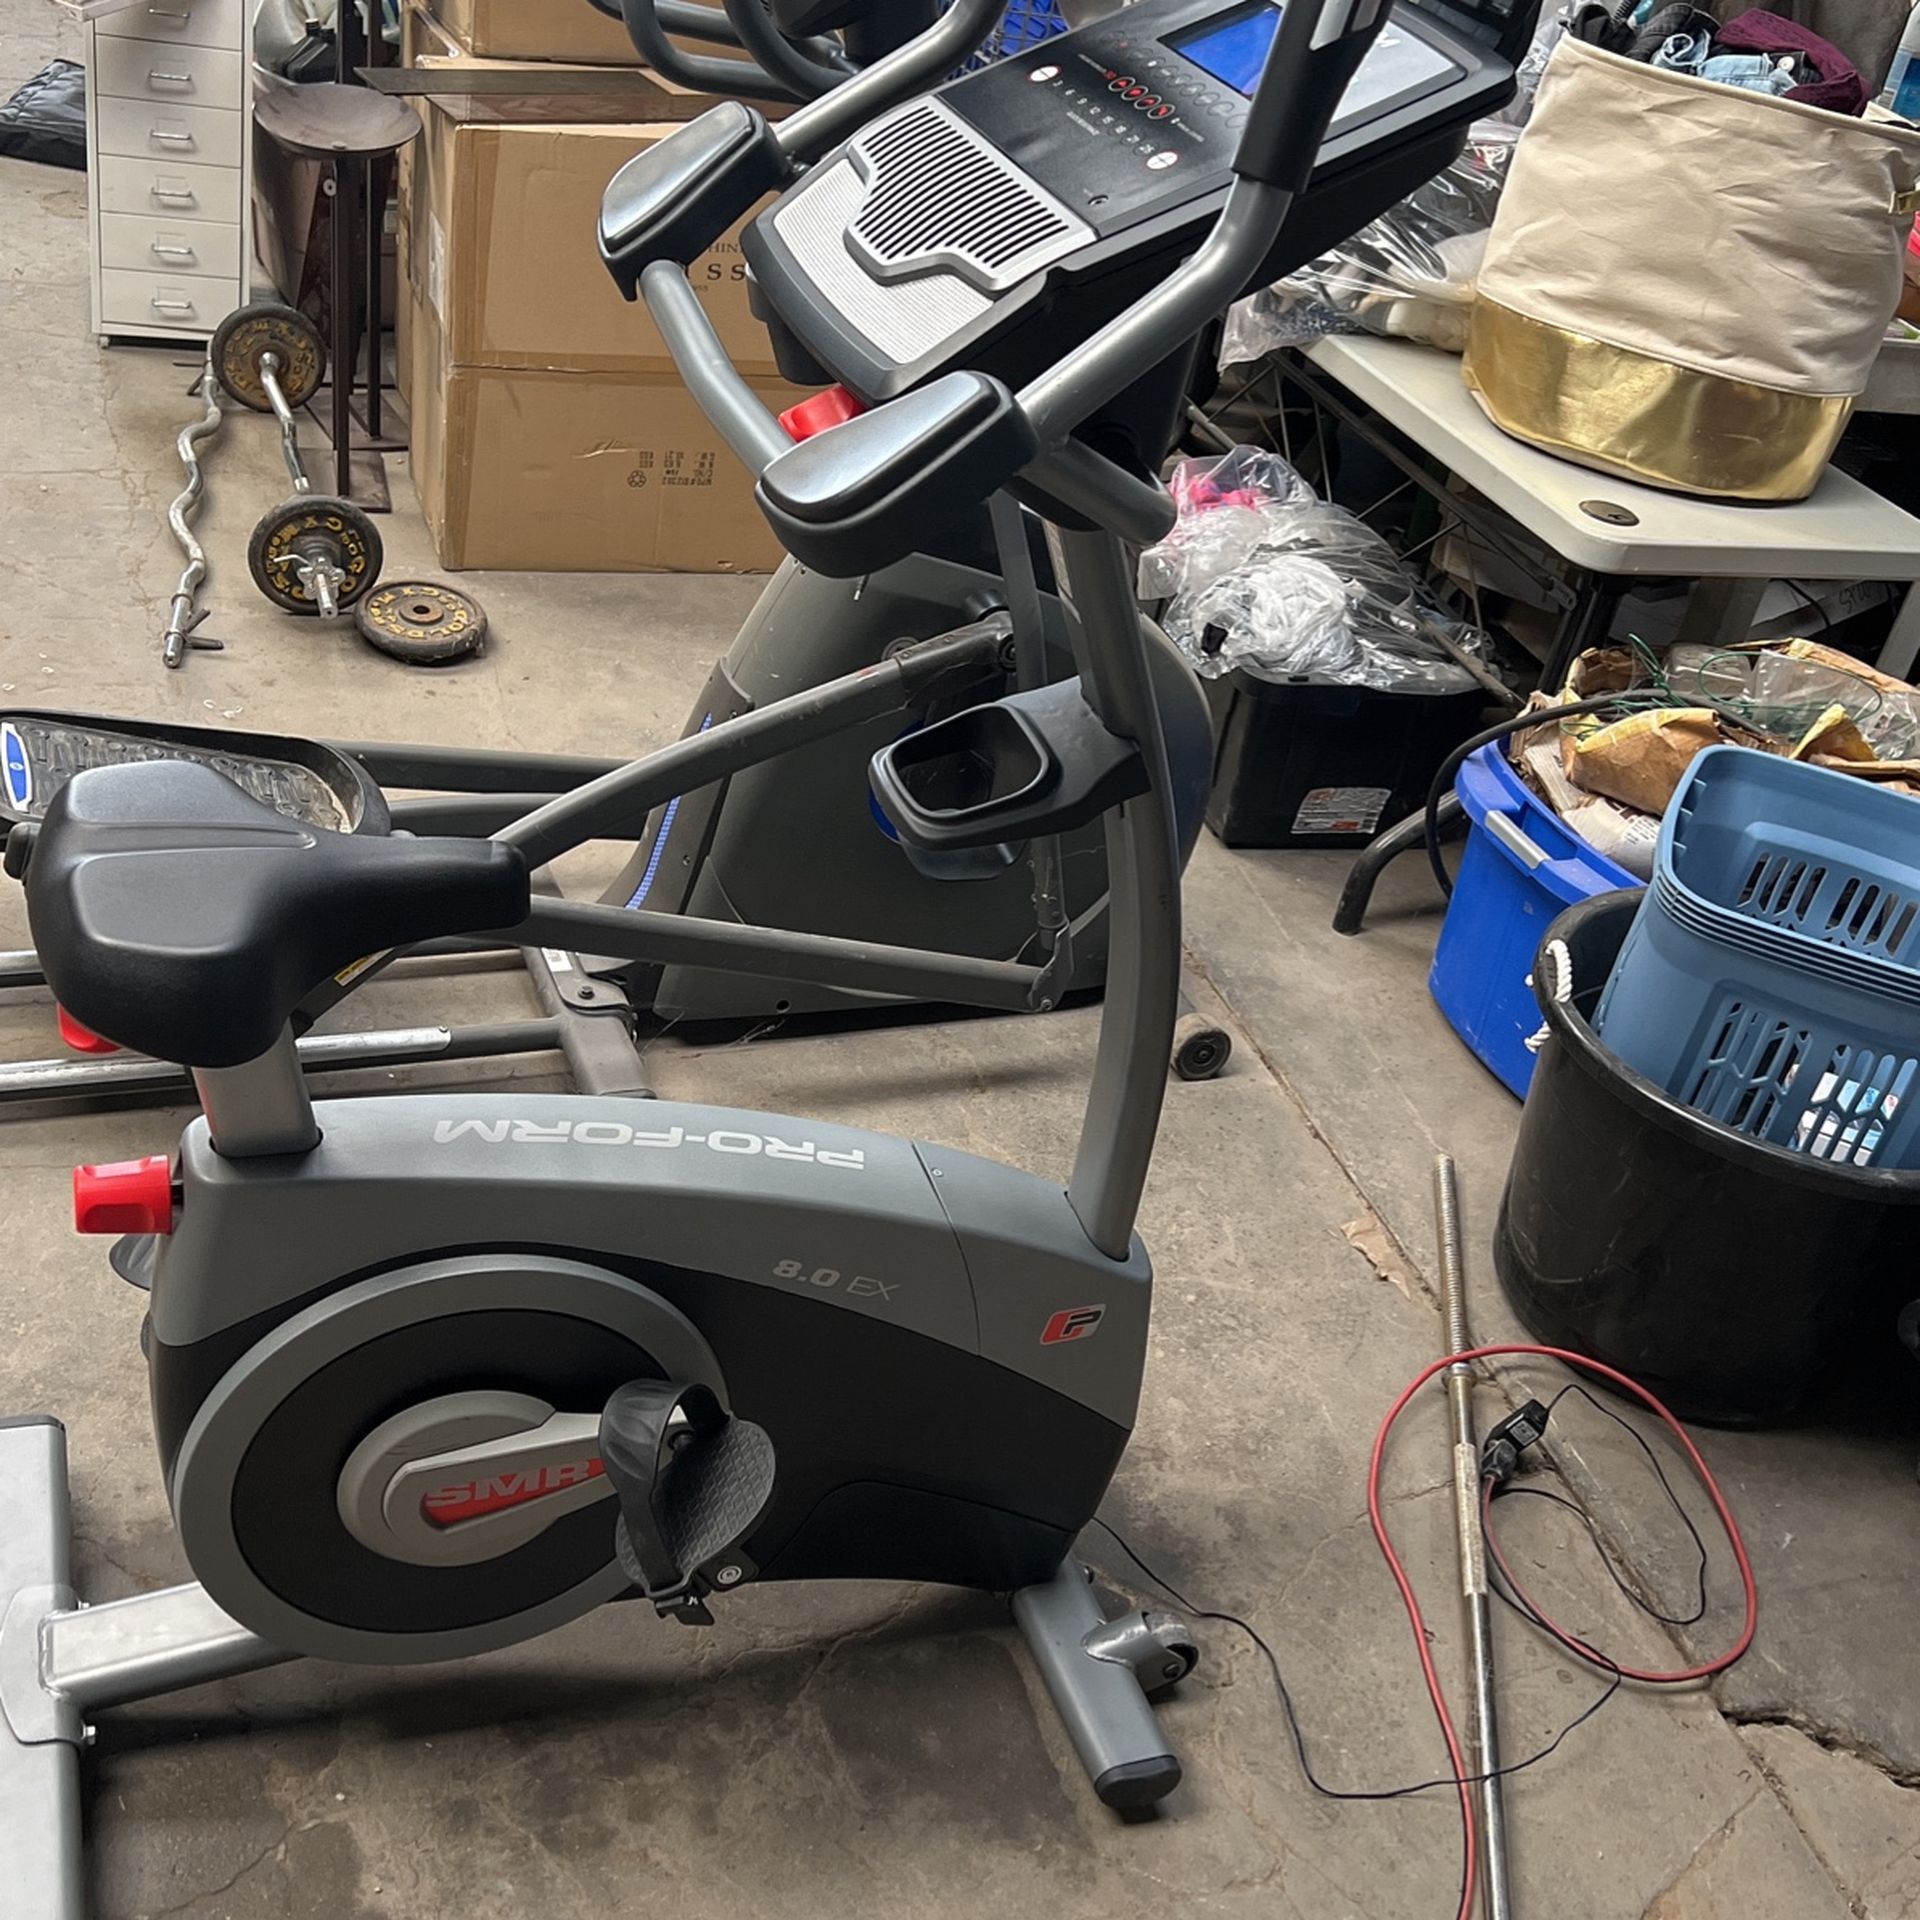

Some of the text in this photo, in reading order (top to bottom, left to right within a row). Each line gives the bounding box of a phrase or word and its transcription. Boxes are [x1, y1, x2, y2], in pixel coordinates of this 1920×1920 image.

[433, 1119, 865, 1170] PRO-FORM
[772, 1258, 900, 1301] 8.0 EX
[425, 1459, 589, 1508] SMR
